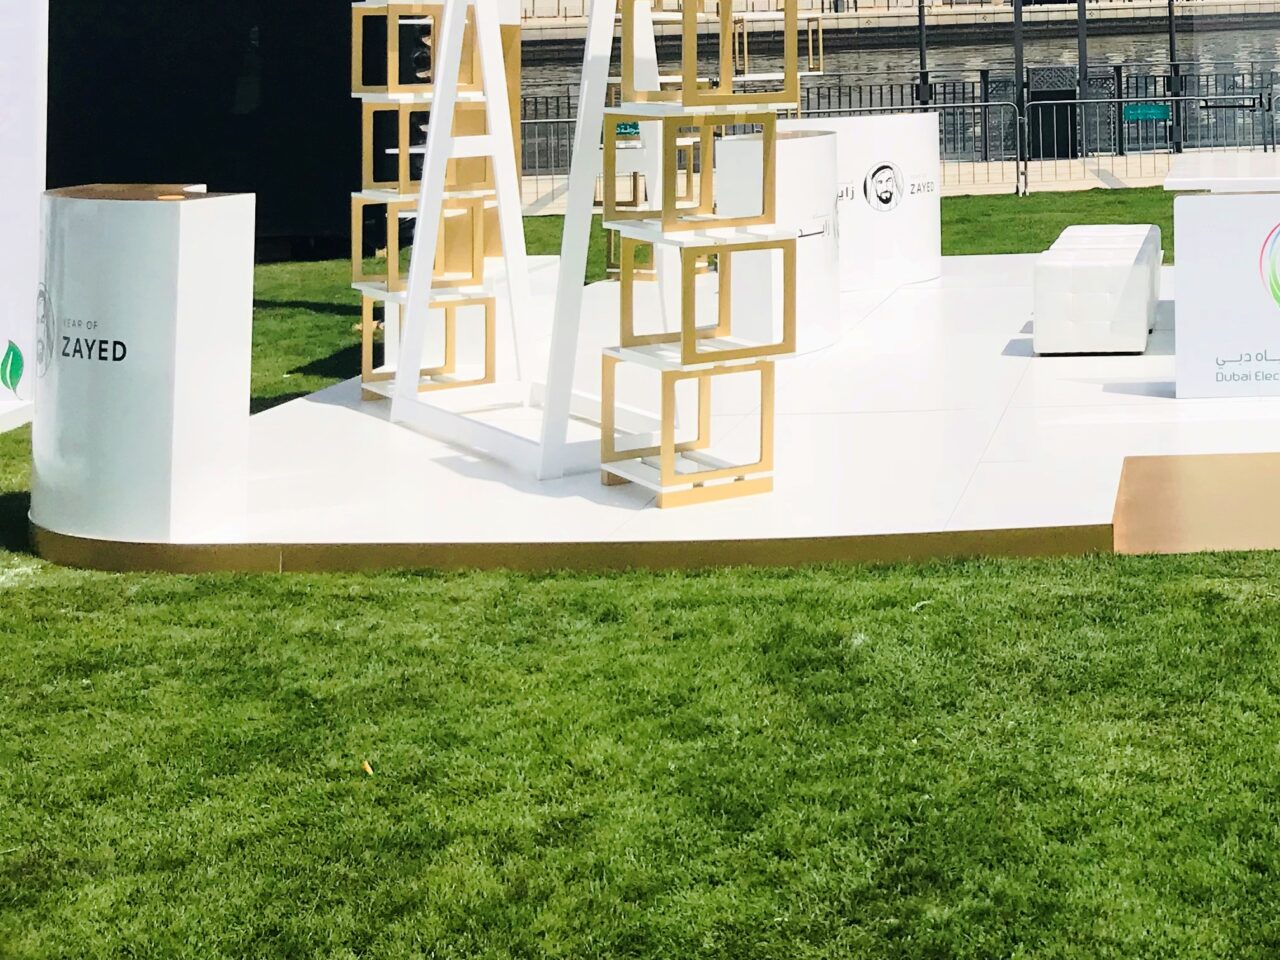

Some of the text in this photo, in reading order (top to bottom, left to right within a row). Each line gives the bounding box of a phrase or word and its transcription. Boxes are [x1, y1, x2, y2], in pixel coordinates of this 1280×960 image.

[1200, 93, 1272, 112] زايد
[910, 181, 935, 195] ZAYED
[86, 320, 98, 330] OF
[62, 335, 127, 362] ZAYED
[1216, 352, 1252, 370] دبي
[1216, 369, 1251, 382] Dubai
